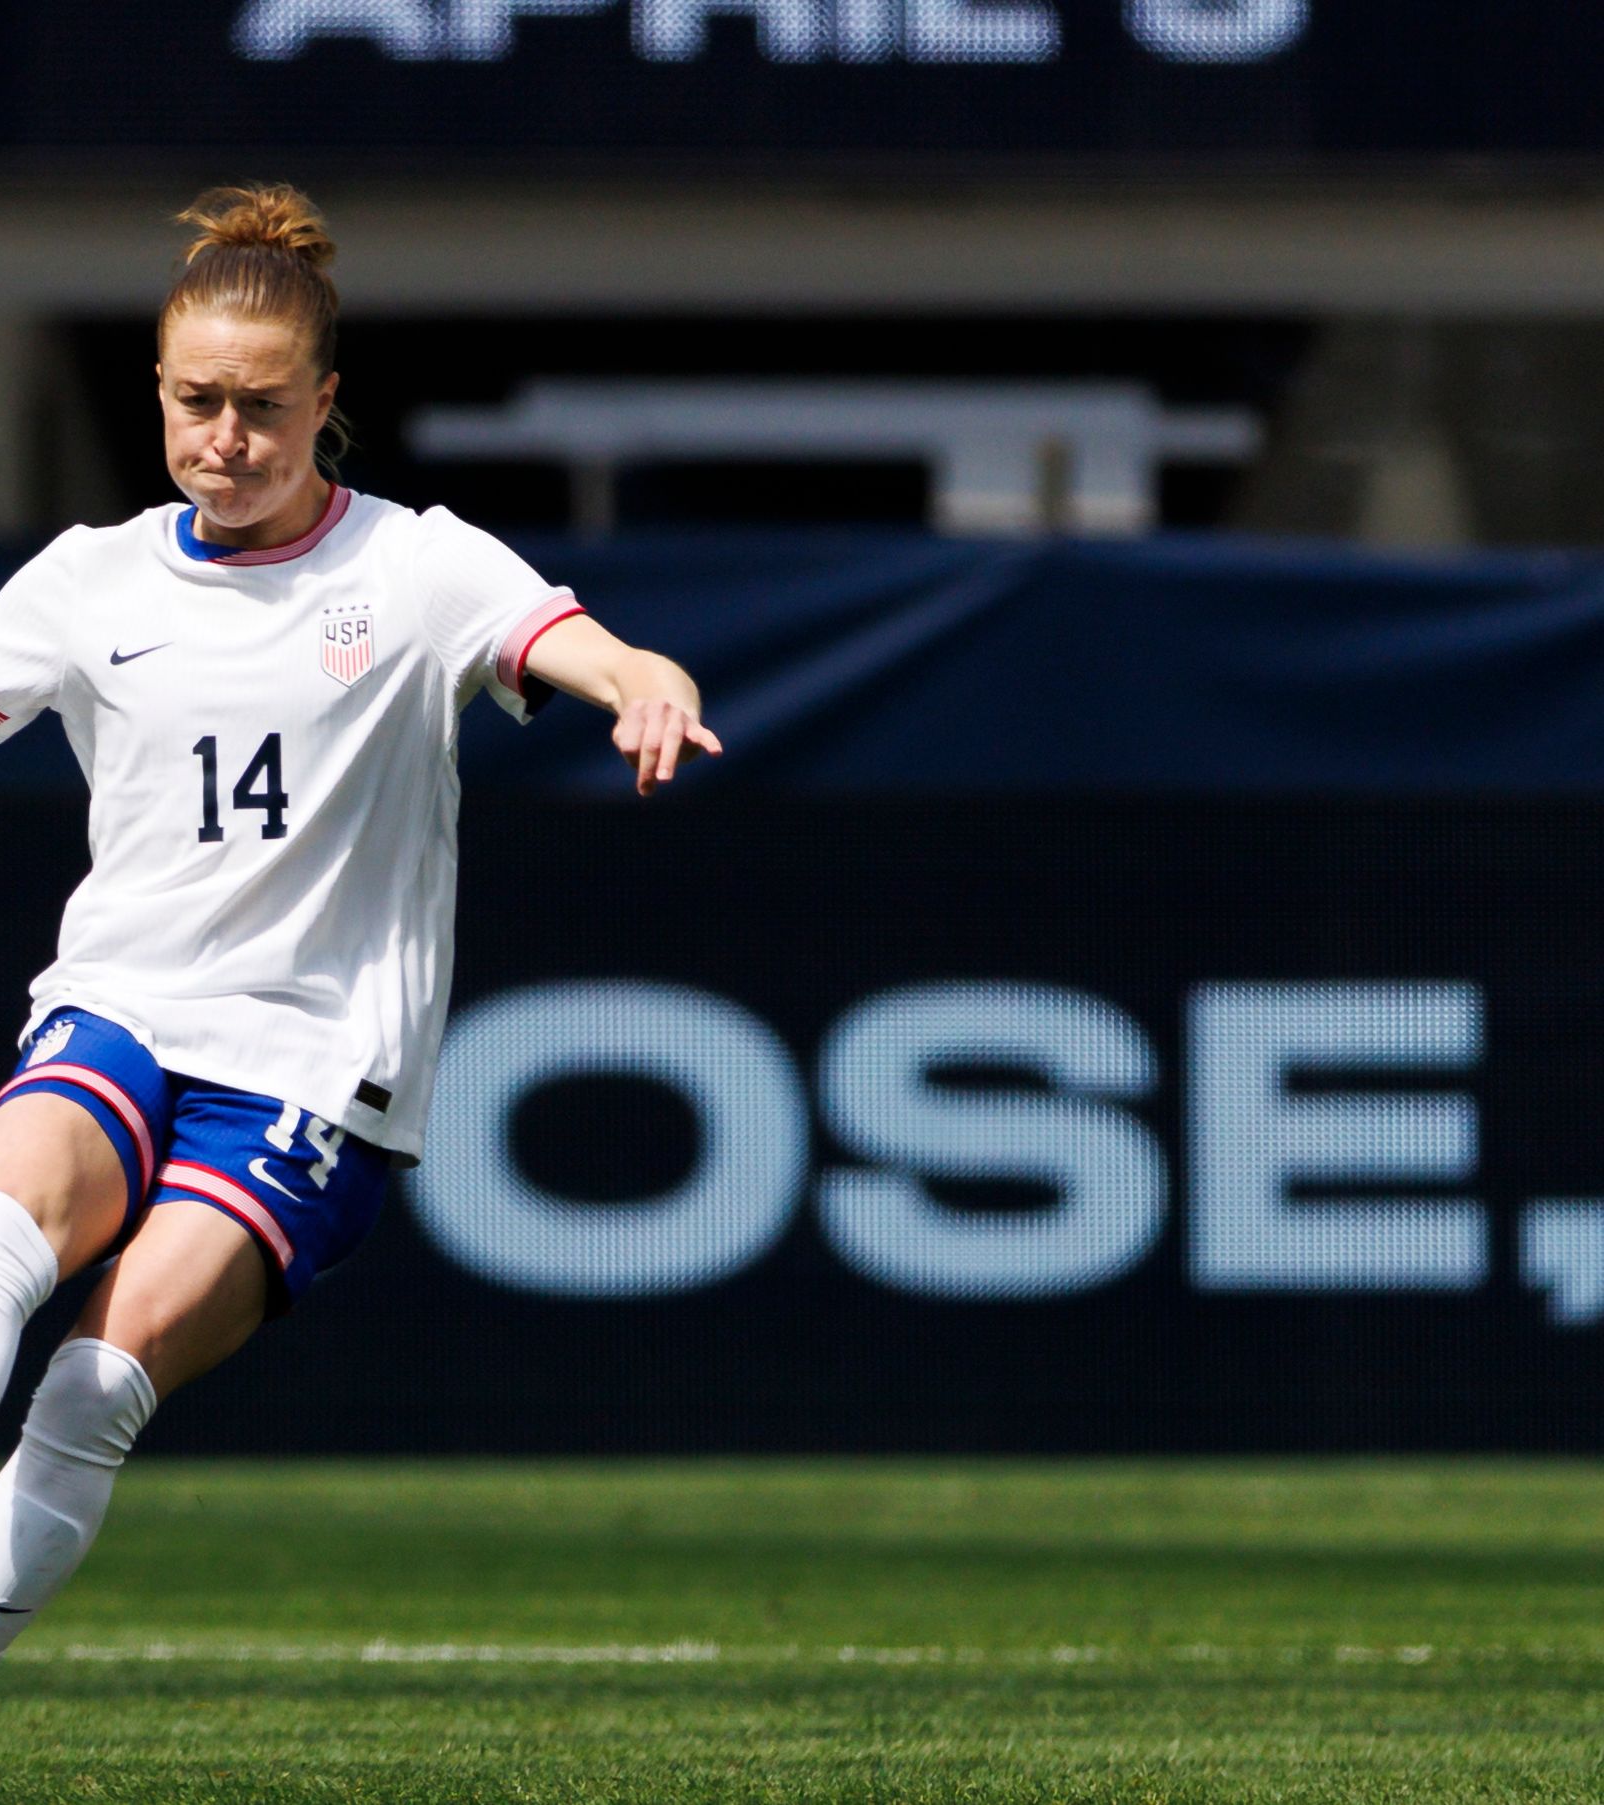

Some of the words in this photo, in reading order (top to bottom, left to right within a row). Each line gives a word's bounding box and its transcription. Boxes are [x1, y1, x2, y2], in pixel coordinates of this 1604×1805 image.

[325, 620, 368, 645] USA
[192, 732, 289, 842] 14
[264, 1101, 347, 1191] 14
[402, 978, 1604, 1324] OSE,
